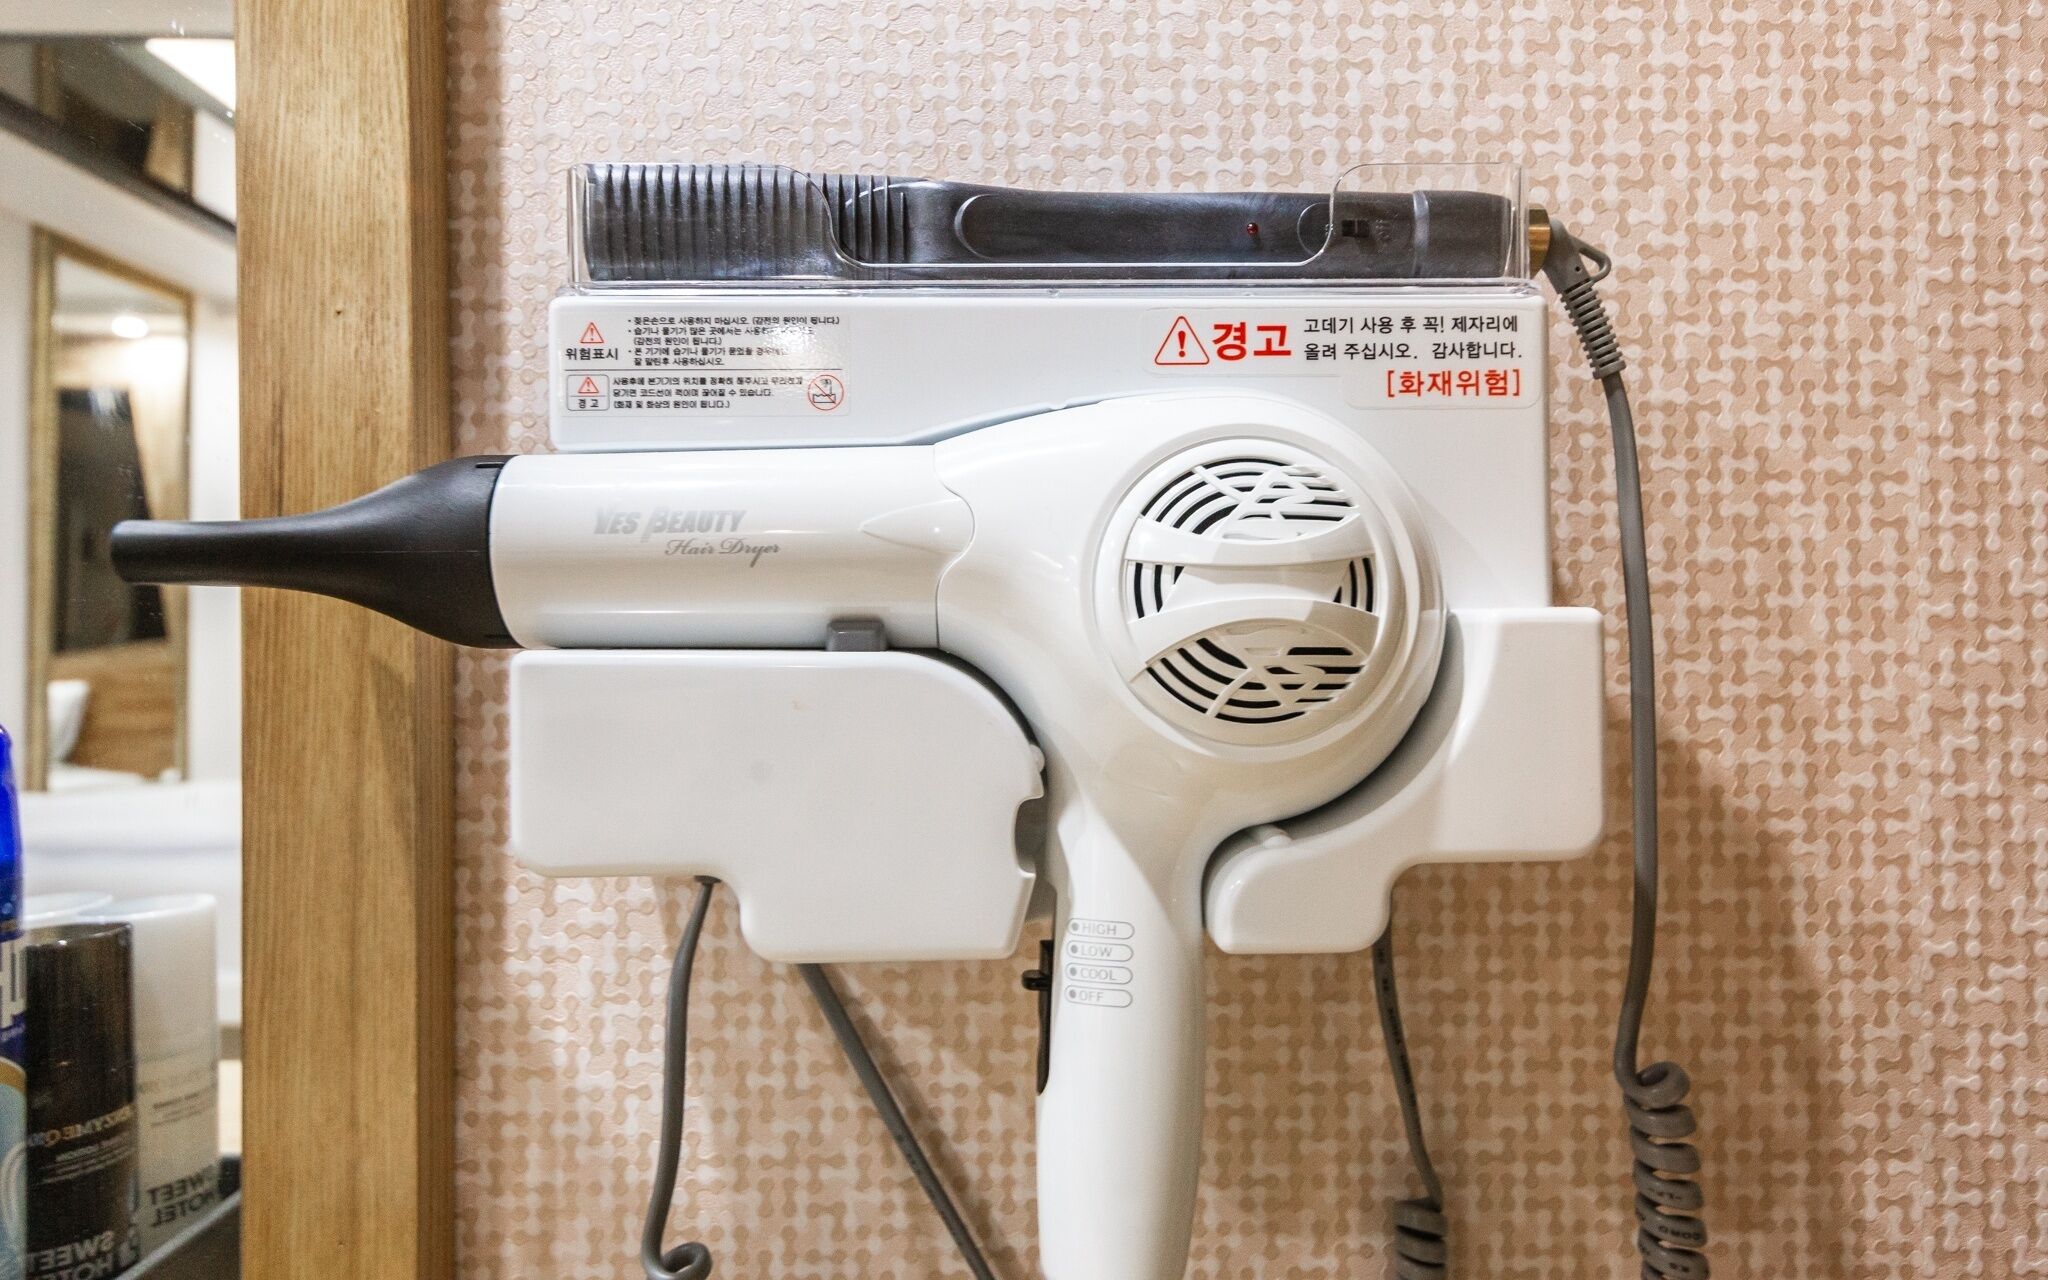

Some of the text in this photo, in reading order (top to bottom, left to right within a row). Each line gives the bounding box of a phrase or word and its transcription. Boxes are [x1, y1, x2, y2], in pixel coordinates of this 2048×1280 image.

[634, 316, 676, 325] 젖은손으로
[679, 316, 712, 325] 사용하지
[752, 316, 780, 325] (감전의
[782, 316, 807, 325] 원인이
[1303, 314, 1519, 334] 고데기 사용 후 꼭! 제자리에
[634, 326, 660, 335] 습기나
[662, 326, 687, 335] 물기가
[689, 326, 706, 335] 많은
[709, 326, 742, 335] 곳에서는
[633, 336, 662, 346] (감전의
[664, 337, 689, 346] 원인이
[1211, 321, 1293, 362] 경고
[566, 347, 619, 361] 위험표시
[634, 347, 642, 356] 본
[645, 347, 669, 356] 기기에
[673, 347, 698, 356] 습기나
[701, 347, 725, 356] 물기가
[1303, 340, 1523, 361] 올려 주십시오. 감사합니다.
[634, 357, 642, 366] 잘
[645, 357, 670, 366] 말린후
[613, 377, 645, 386] 사용후에
[648, 377, 680, 386] 본기기의
[683, 377, 706, 385] 위치를
[710, 376, 734, 385] 정확히
[1386, 369, 1522, 399] [화재위험]
[613, 388, 637, 397] 당기면
[640, 388, 672, 397] 코드선이
[728, 389, 737, 397] 수
[613, 400, 633, 410] (화재
[635, 400, 643, 409] 및
[646, 400, 670, 409] 화상의
[673, 400, 697, 409] 원인이
[664, 537, 782, 568] Hair Dryer
[1081, 922, 1117, 936] HIGH
[1080, 945, 1112, 957] LOW
[1080, 967, 1118, 981] COOL
[1078, 990, 1104, 1003] OFF
